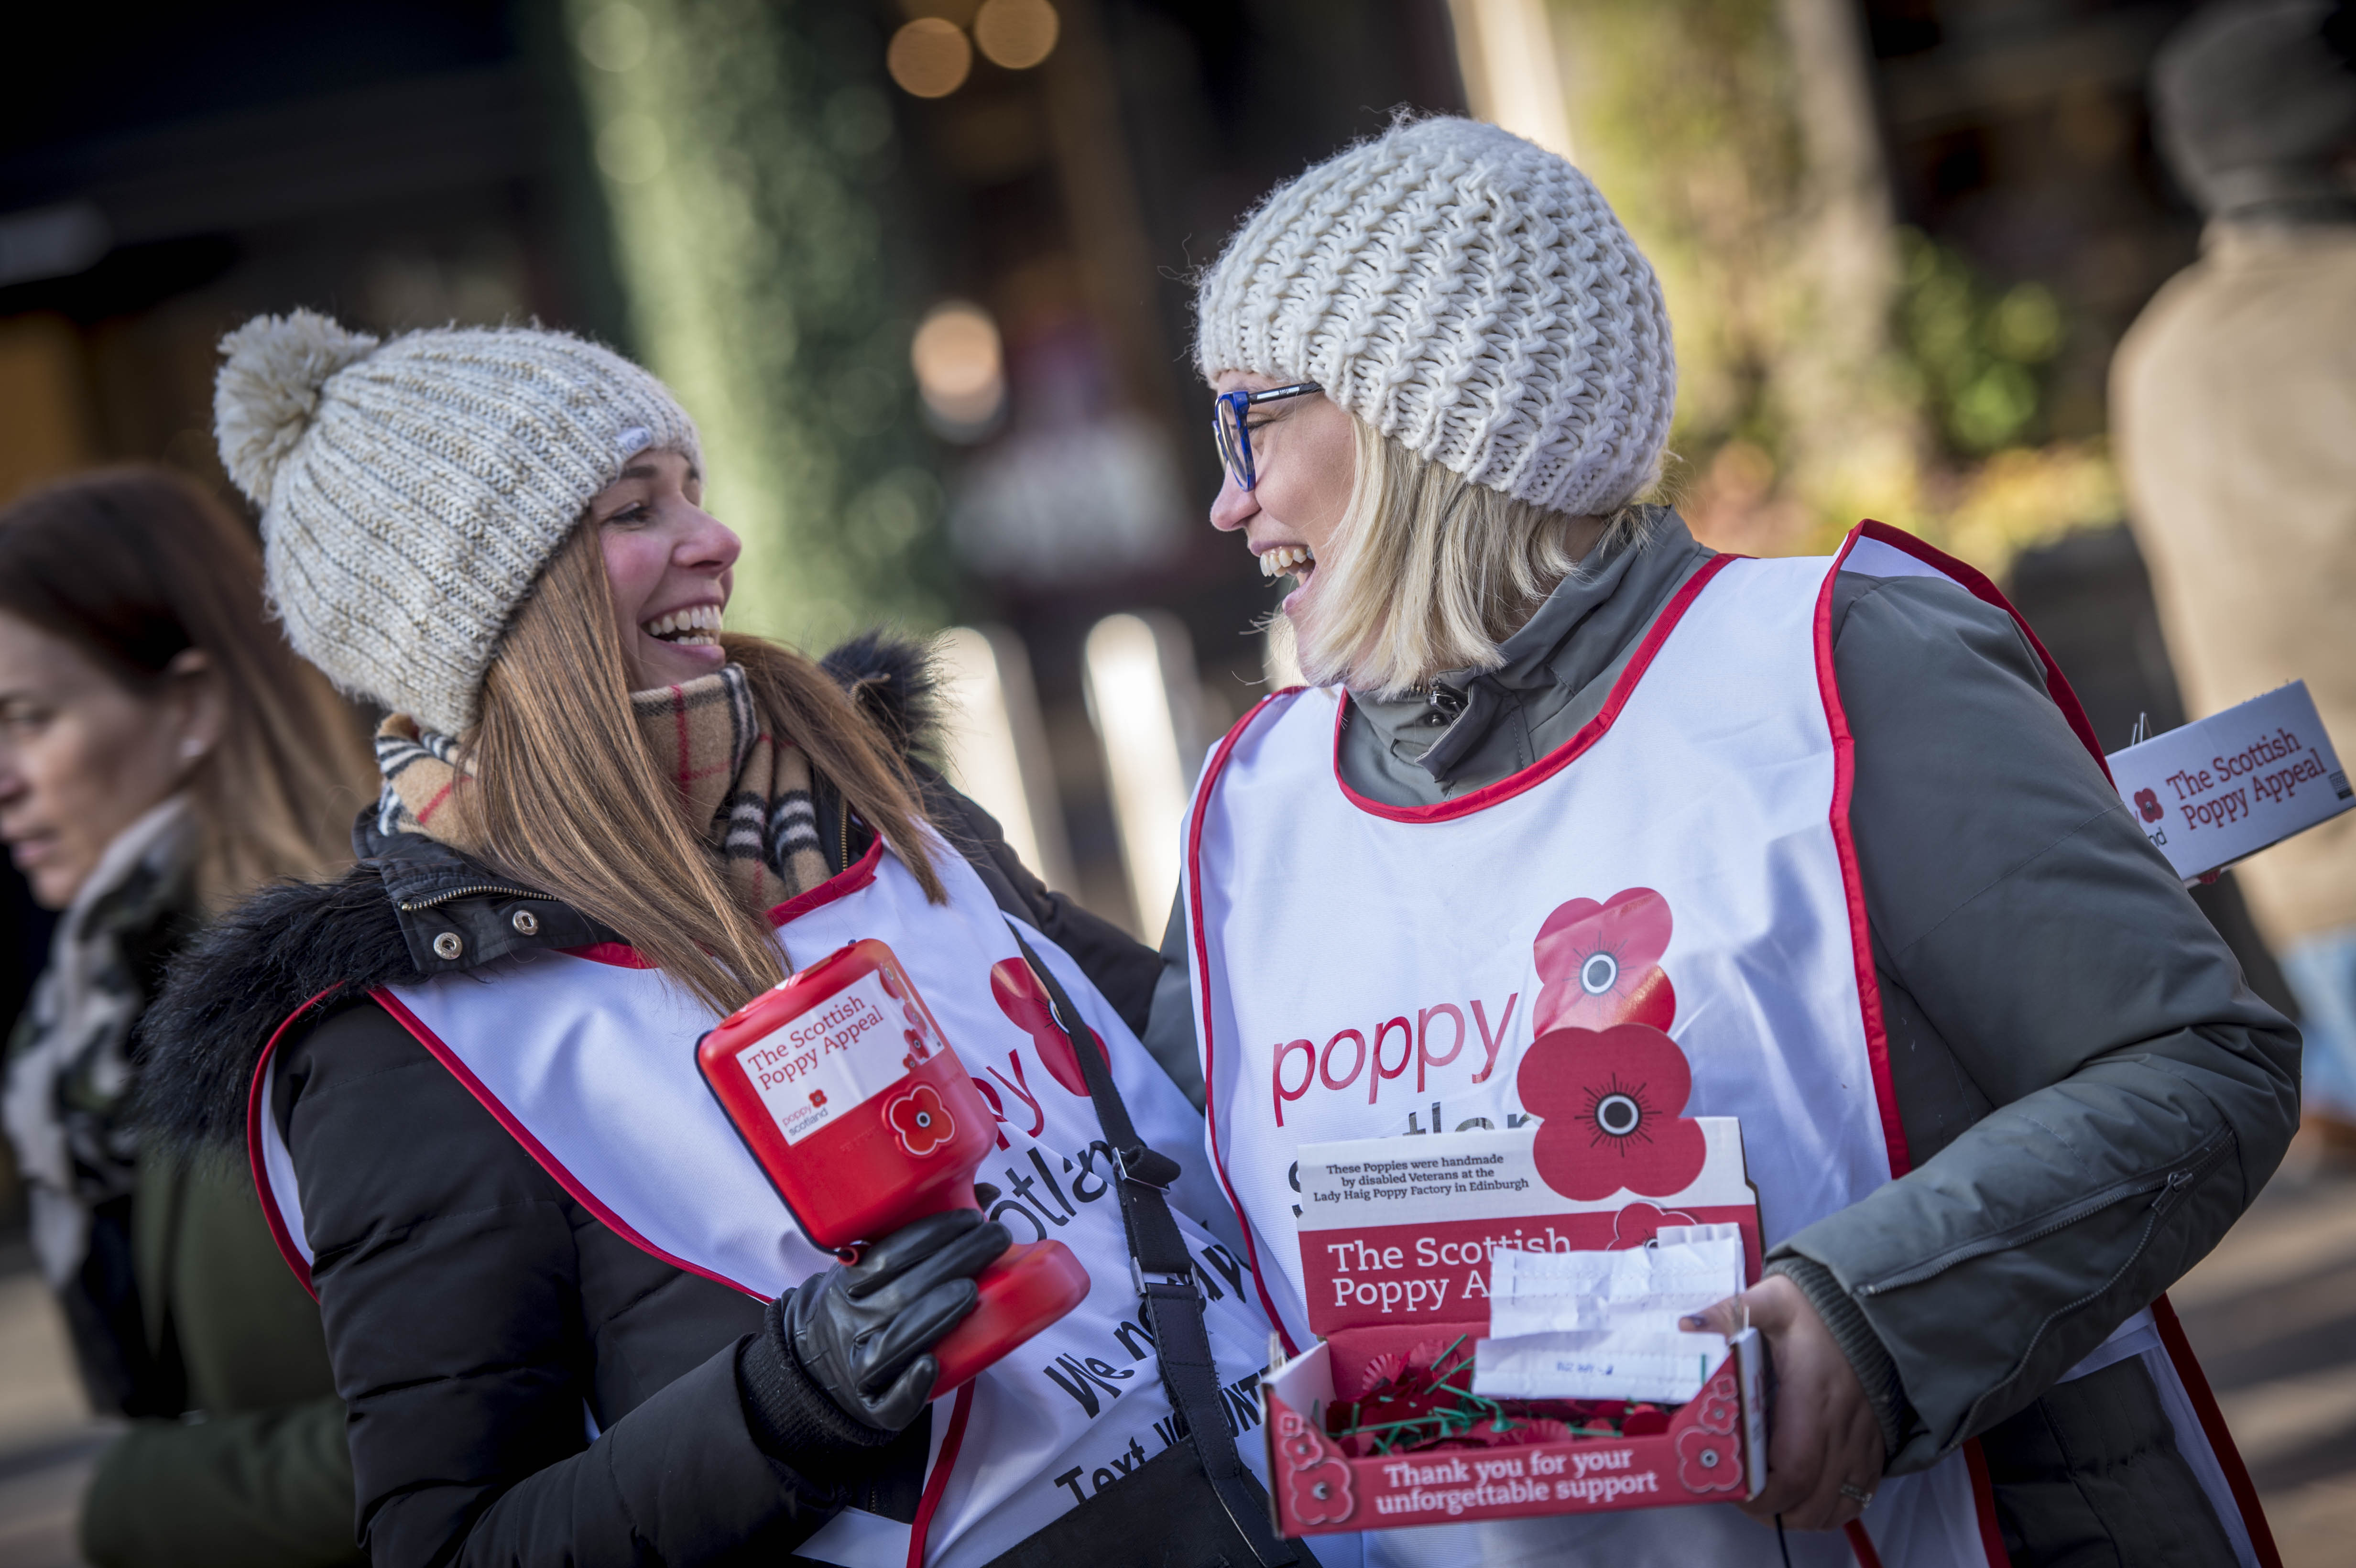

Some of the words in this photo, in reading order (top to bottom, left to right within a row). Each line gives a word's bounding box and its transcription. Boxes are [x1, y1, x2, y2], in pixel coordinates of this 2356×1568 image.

[2166, 769, 2214, 800] The
[2213, 728, 2301, 783] Scottish
[2181, 786, 2248, 831] Poppy
[2252, 748, 2326, 803] Appeal
[747, 1044, 788, 1071] The
[790, 996, 865, 1048] Scottish
[758, 1048, 818, 1090] Poppy
[824, 1005, 884, 1054] Appeal
[1272, 992, 1518, 1128] poppy
[782, 1104, 812, 1127] poppy
[789, 1107, 828, 1136] scotland
[1326, 1164, 1361, 1175] These
[1363, 1160, 1408, 1174] Poppies
[1410, 1160, 1439, 1169] were
[1441, 1154, 1504, 1167] handmade
[1341, 1176, 1355, 1189] by
[1358, 1173, 1407, 1186] disabled
[1408, 1171, 1458, 1182] Veterans
[1462, 1169, 1473, 1179] at
[1475, 1167, 1494, 1178] the
[1313, 1190, 1341, 1203] Lady
[1344, 1189, 1371, 1201] Haig
[1373, 1187, 1407, 1199] Poppy
[1410, 1184, 1451, 1196] Factory
[1454, 1182, 1467, 1193] in
[1469, 1177, 1529, 1191] Edinburgh
[1328, 1239, 1404, 1273] The
[1332, 1276, 1449, 1313] Poppy
[1044, 1352, 1134, 1419] We
[1382, 1457, 1470, 1488] Thank
[1473, 1457, 1524, 1484] you
[1529, 1450, 1567, 1476] for
[1571, 1448, 1634, 1479] your
[1374, 1478, 1550, 1516] unforgettable
[1555, 1470, 1659, 1504] support
